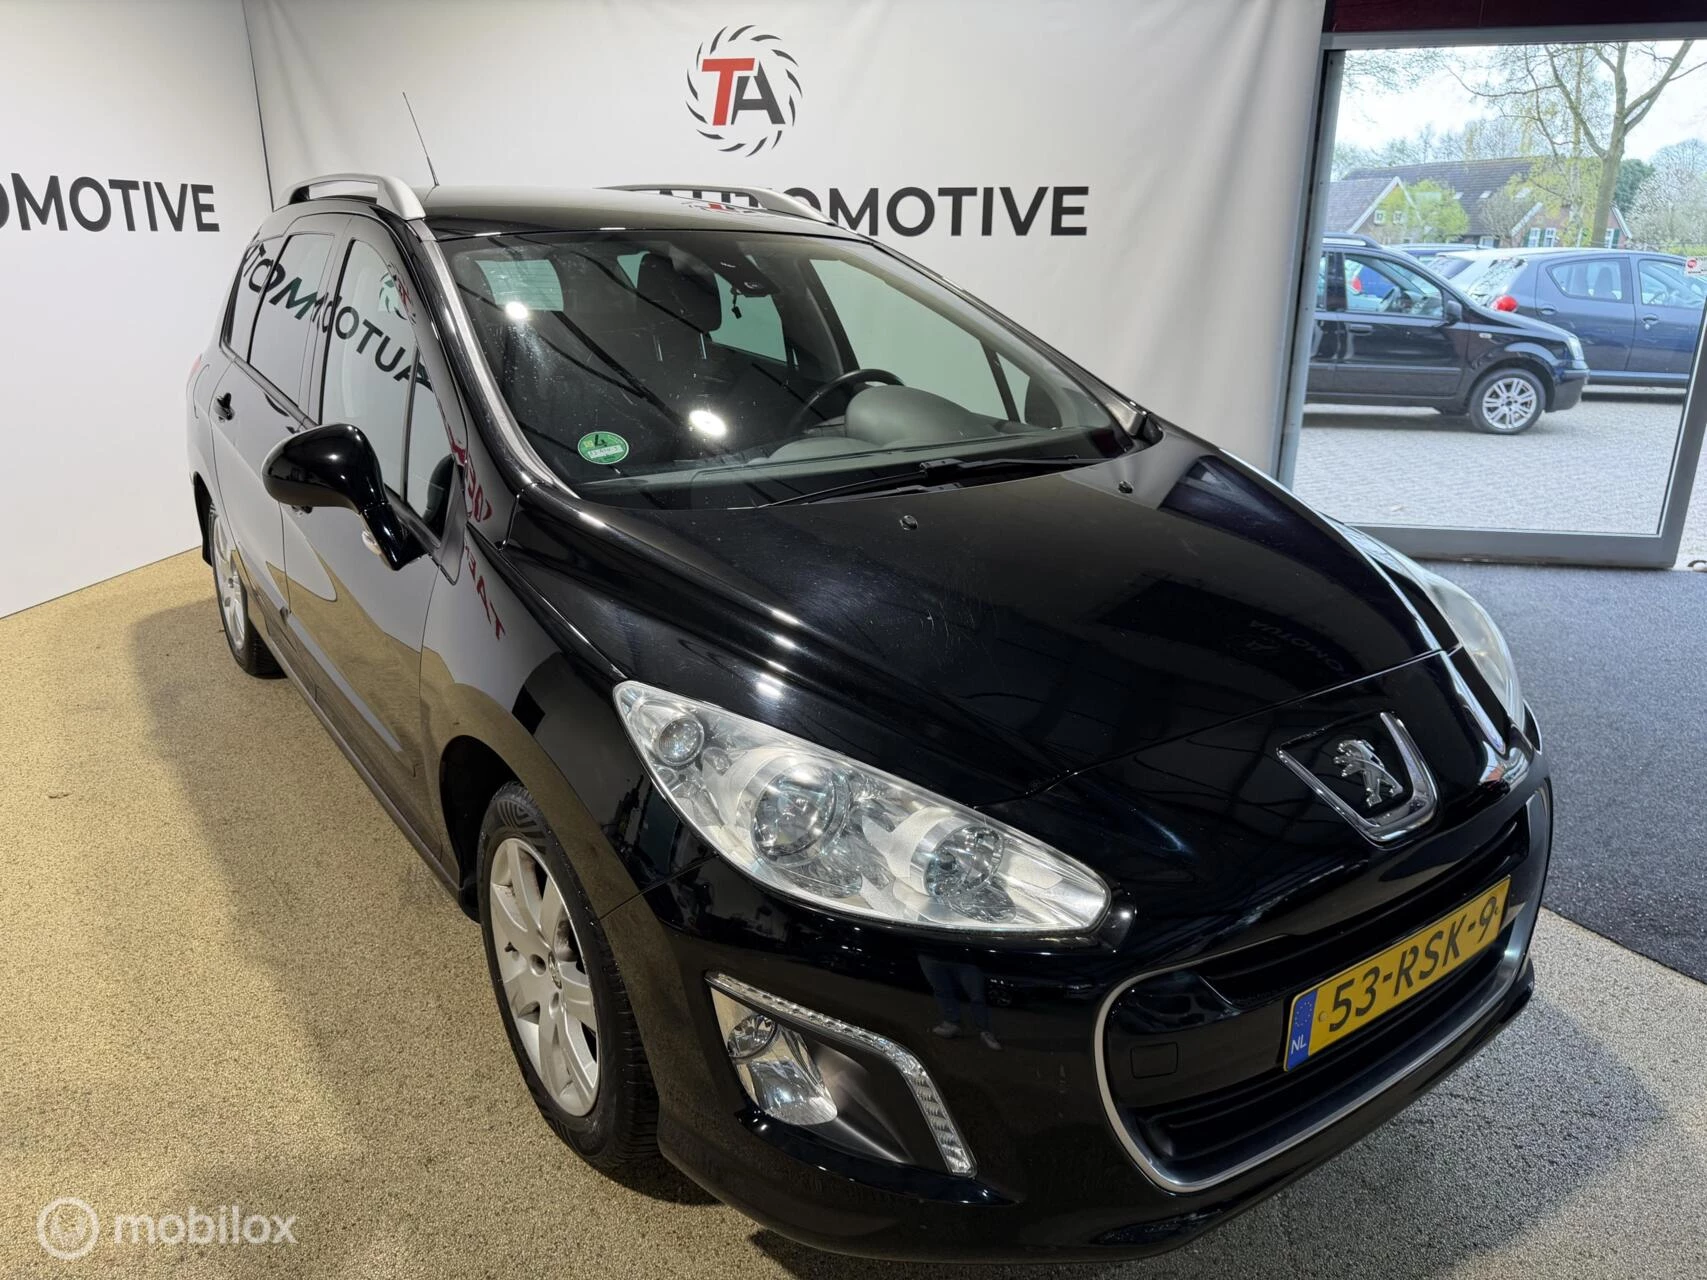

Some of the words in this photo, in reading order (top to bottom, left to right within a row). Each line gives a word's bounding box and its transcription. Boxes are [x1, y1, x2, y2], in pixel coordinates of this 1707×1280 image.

[701, 57, 786, 126] TA
[0, 172, 220, 232] MOTIVE
[659, 186, 1089, 237] MOTIVE
[1328, 895, 1497, 1033] 53-RSK-9
[1291, 1034, 1306, 1055] NL
